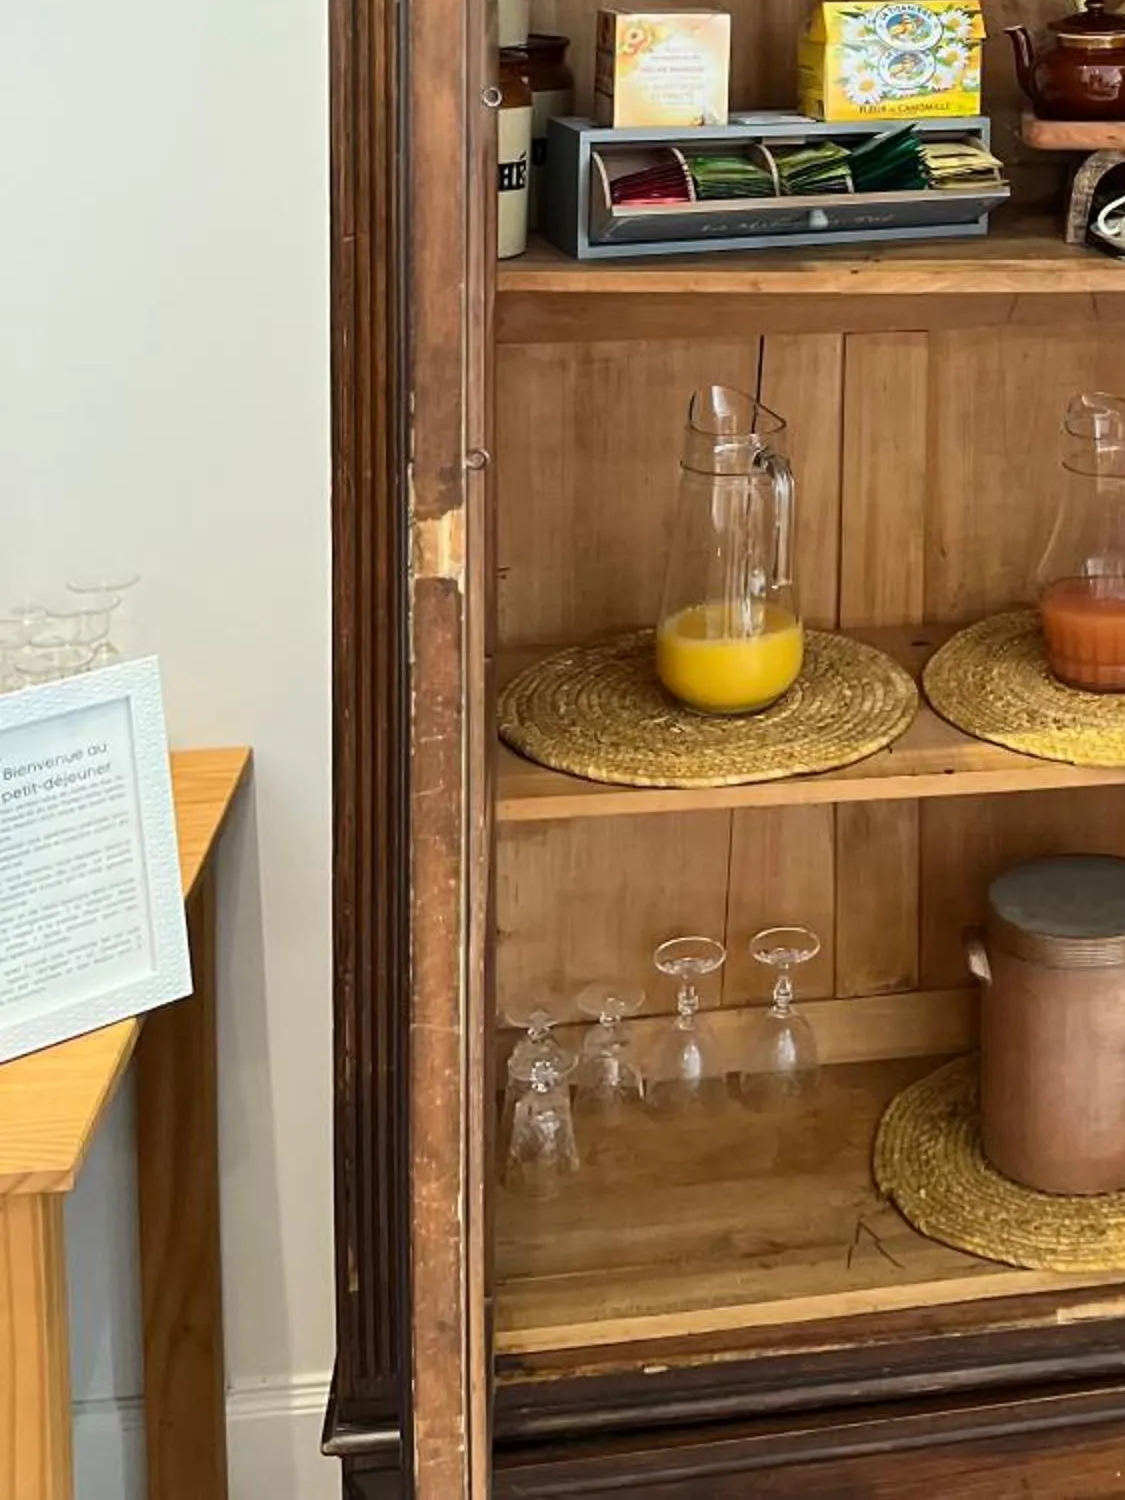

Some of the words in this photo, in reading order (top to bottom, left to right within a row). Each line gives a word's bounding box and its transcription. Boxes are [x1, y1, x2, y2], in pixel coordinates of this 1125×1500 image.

[498, 150, 527, 191] HÉ
[3, 750, 83, 781] Bienvenue
[87, 743, 107, 756] au
[1, 762, 110, 804] petit-déjeuner
